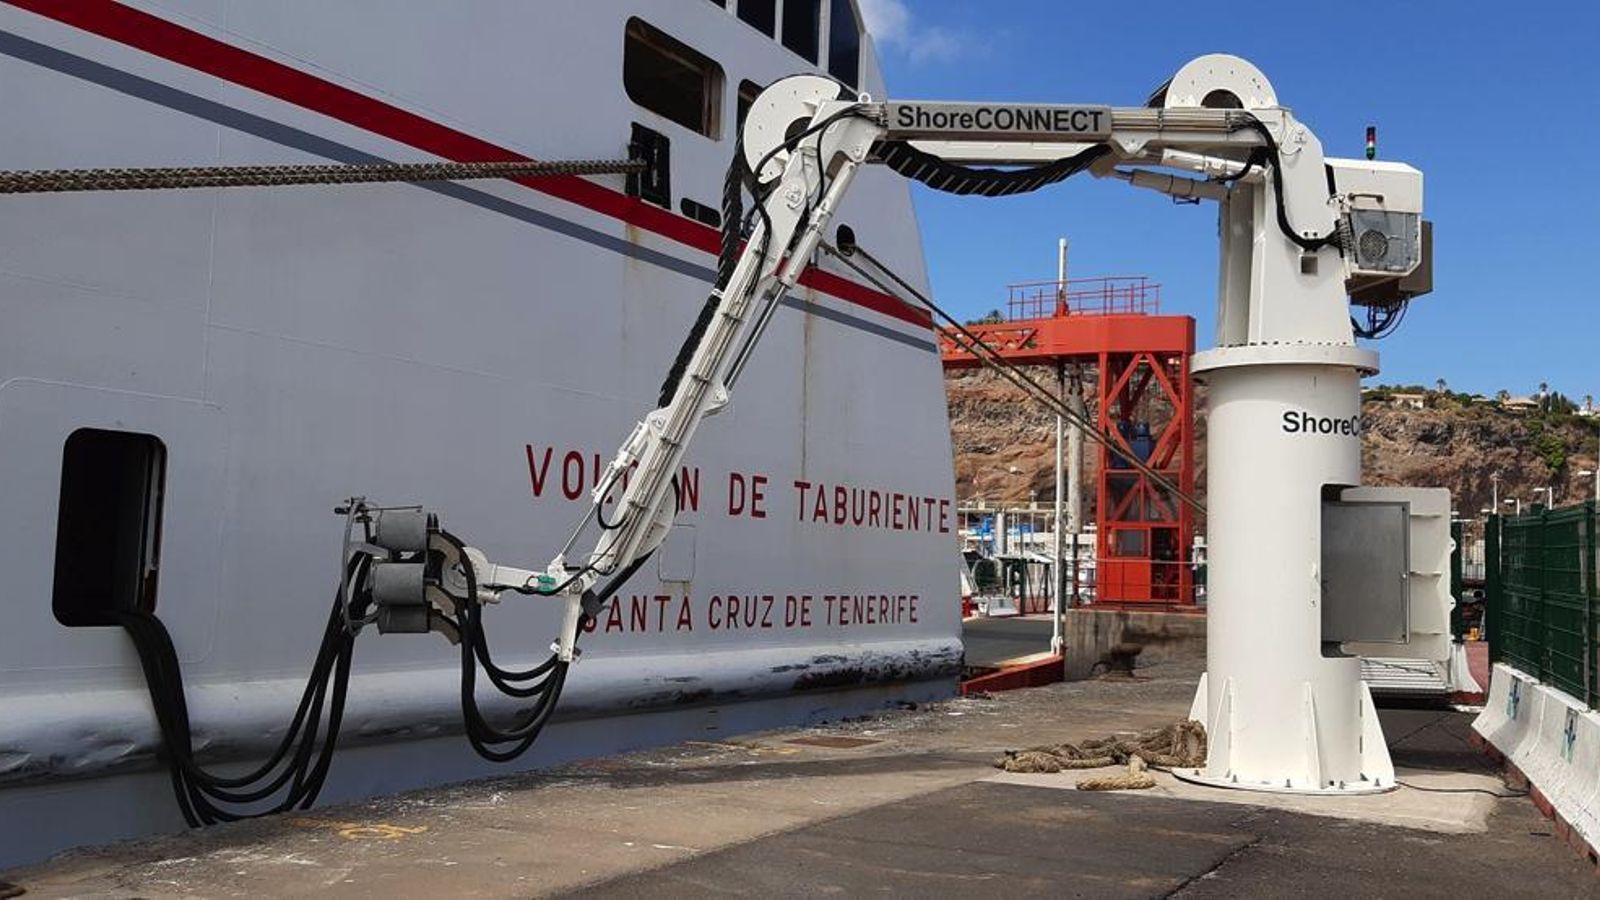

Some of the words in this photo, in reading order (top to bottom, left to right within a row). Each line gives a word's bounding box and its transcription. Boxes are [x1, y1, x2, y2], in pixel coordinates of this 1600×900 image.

[897, 105, 1103, 132] ShoreCONNECT
[526, 444, 699, 512] VOLN
[729, 473, 768, 518] DE
[795, 481, 949, 533] TABURIENTE
[708, 595, 773, 629] CRUZ
[785, 595, 812, 627] DE
[823, 595, 919, 625] TENERIFE
